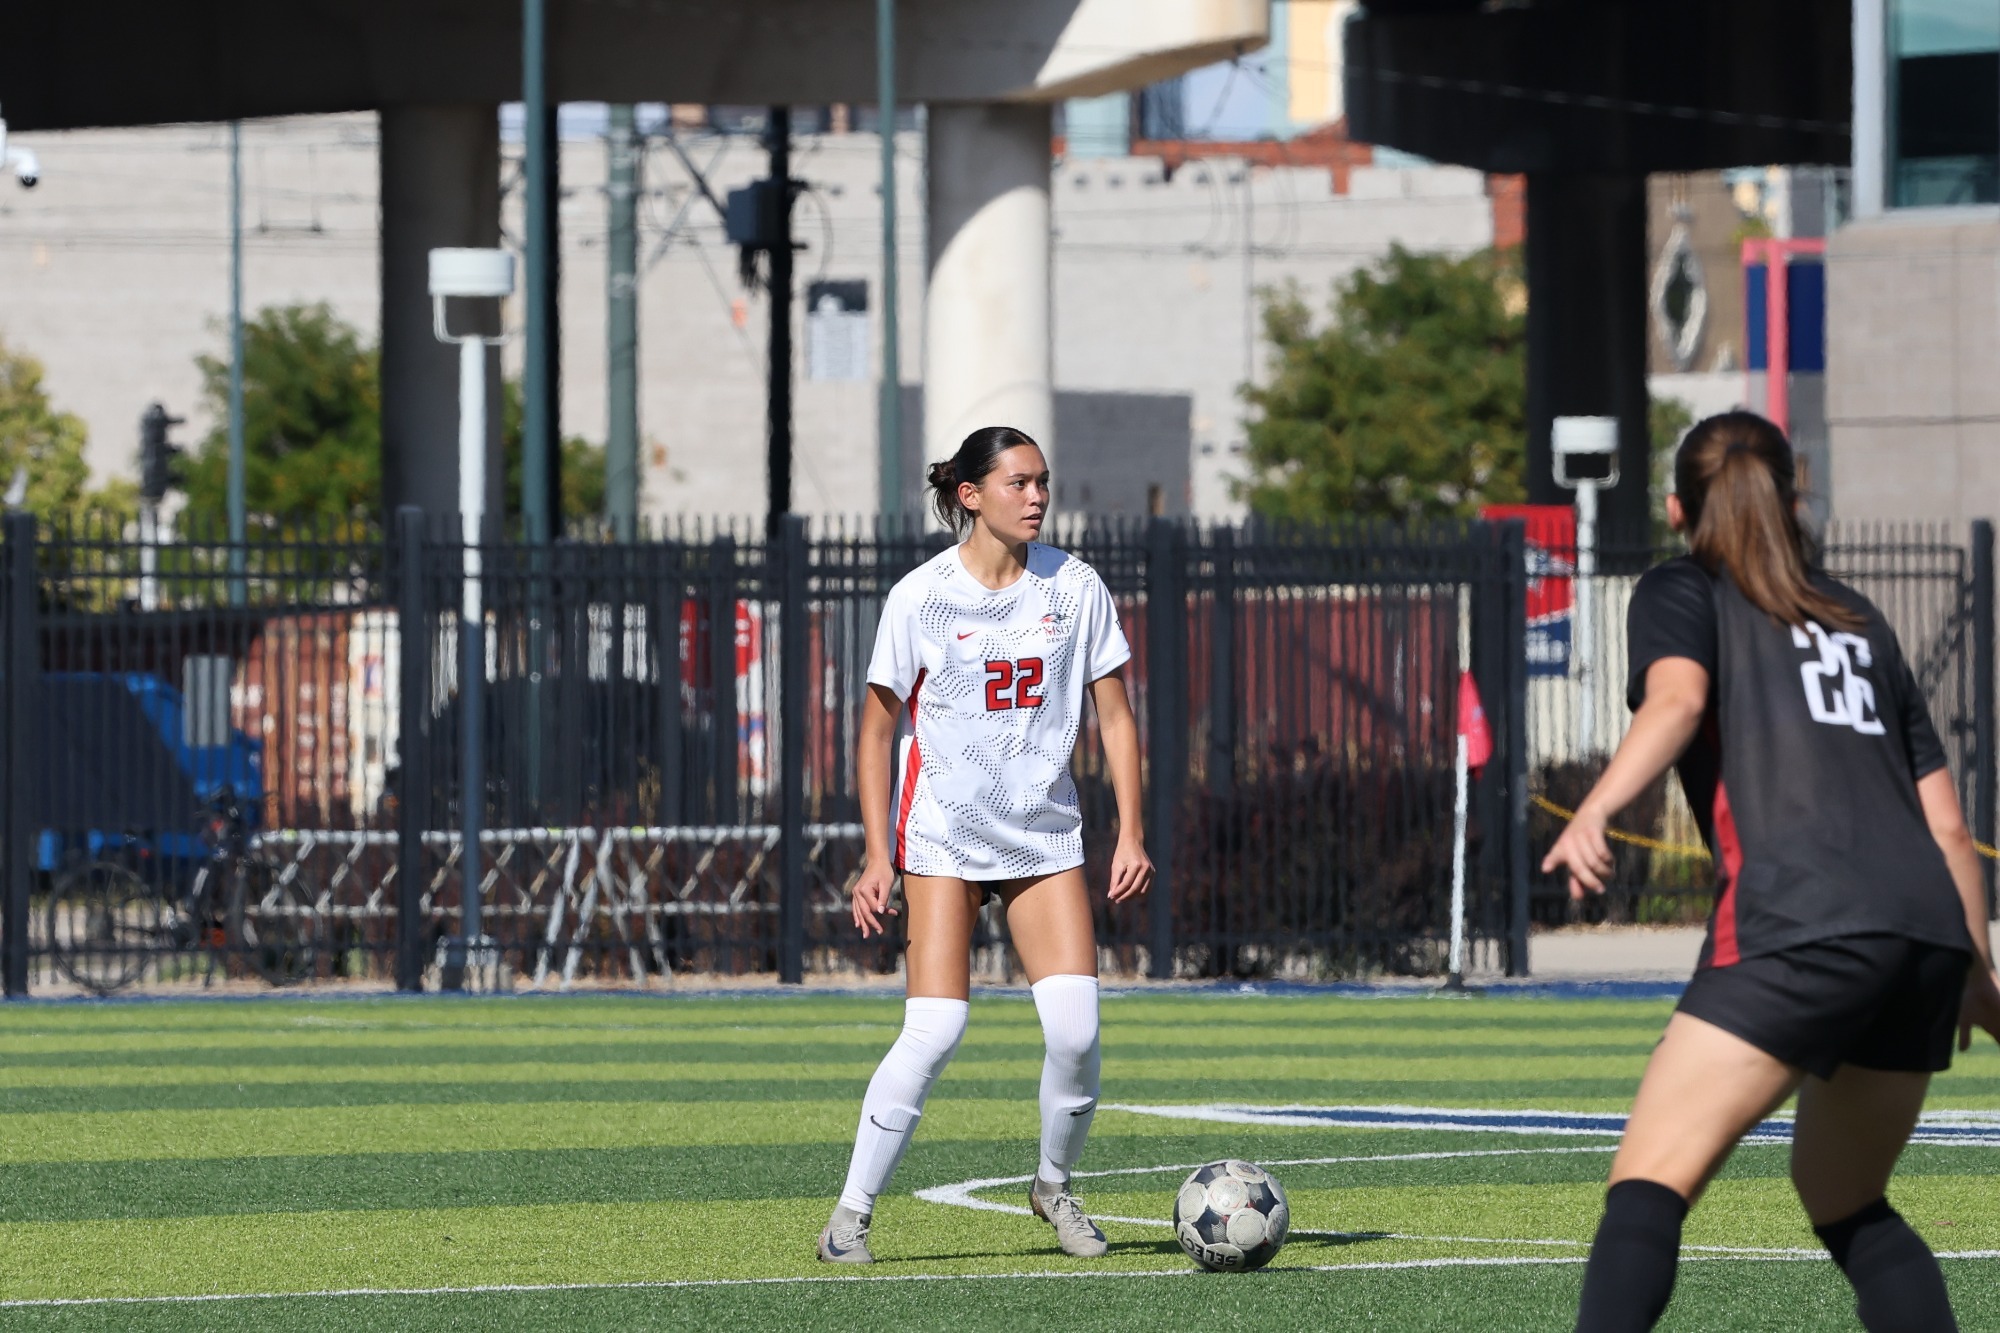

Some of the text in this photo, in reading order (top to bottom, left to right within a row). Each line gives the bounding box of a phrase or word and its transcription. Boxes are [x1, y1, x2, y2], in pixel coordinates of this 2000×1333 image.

[1043, 625, 1070, 637] MSU
[985, 657, 1043, 712] 22
[1180, 1231, 1238, 1267] SELECT
